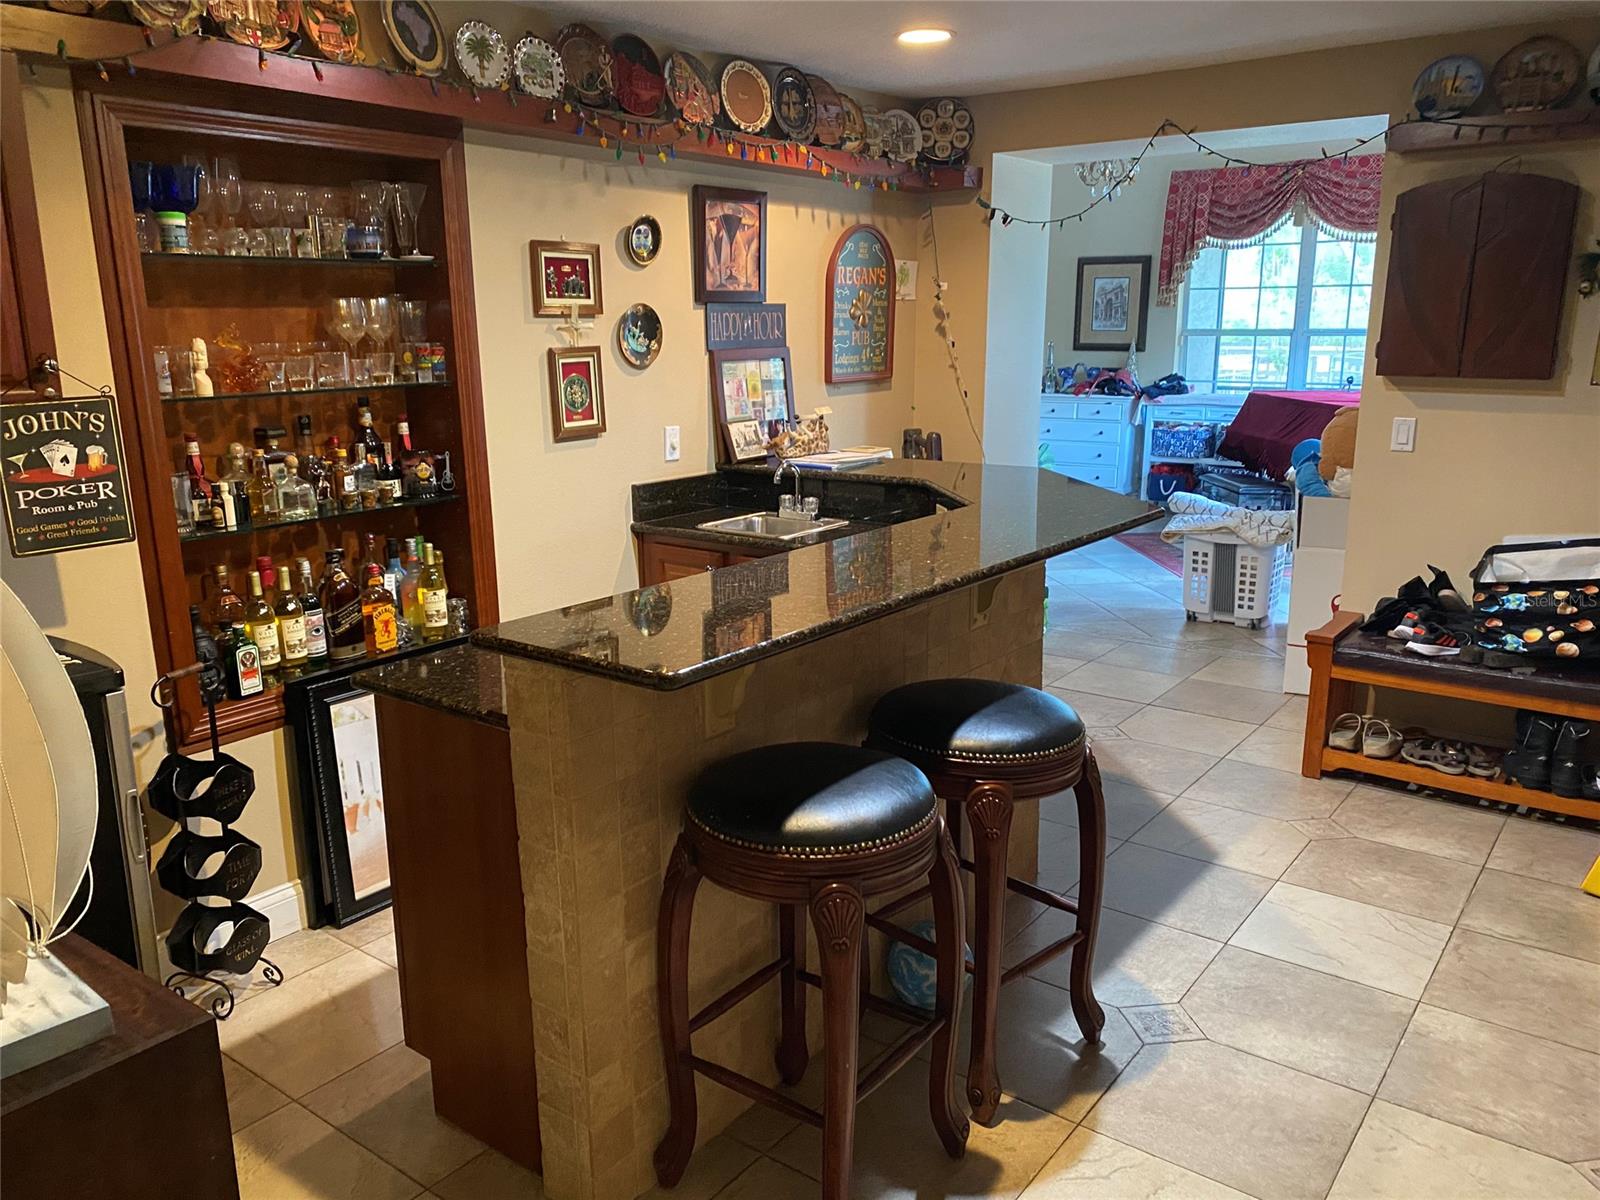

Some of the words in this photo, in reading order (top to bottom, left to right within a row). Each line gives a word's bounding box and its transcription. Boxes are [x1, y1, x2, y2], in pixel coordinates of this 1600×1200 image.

[838, 266, 886, 287] REGAN'S
[710, 312, 743, 340] HAPPY
[754, 312, 783, 339] HOUR
[851, 330, 870, 346] PUB
[3, 410, 105, 440] JOHN'S
[15, 481, 117, 509] POKER
[32, 504, 66, 516] Room
[77, 500, 98, 509] Pub
[16, 525, 39, 534] Good
[40, 522, 68, 531] Games
[77, 517, 98, 527] Good
[99, 513, 125, 523] Drinks
[46, 530, 69, 540] Great
[71, 526, 100, 536] Friends
